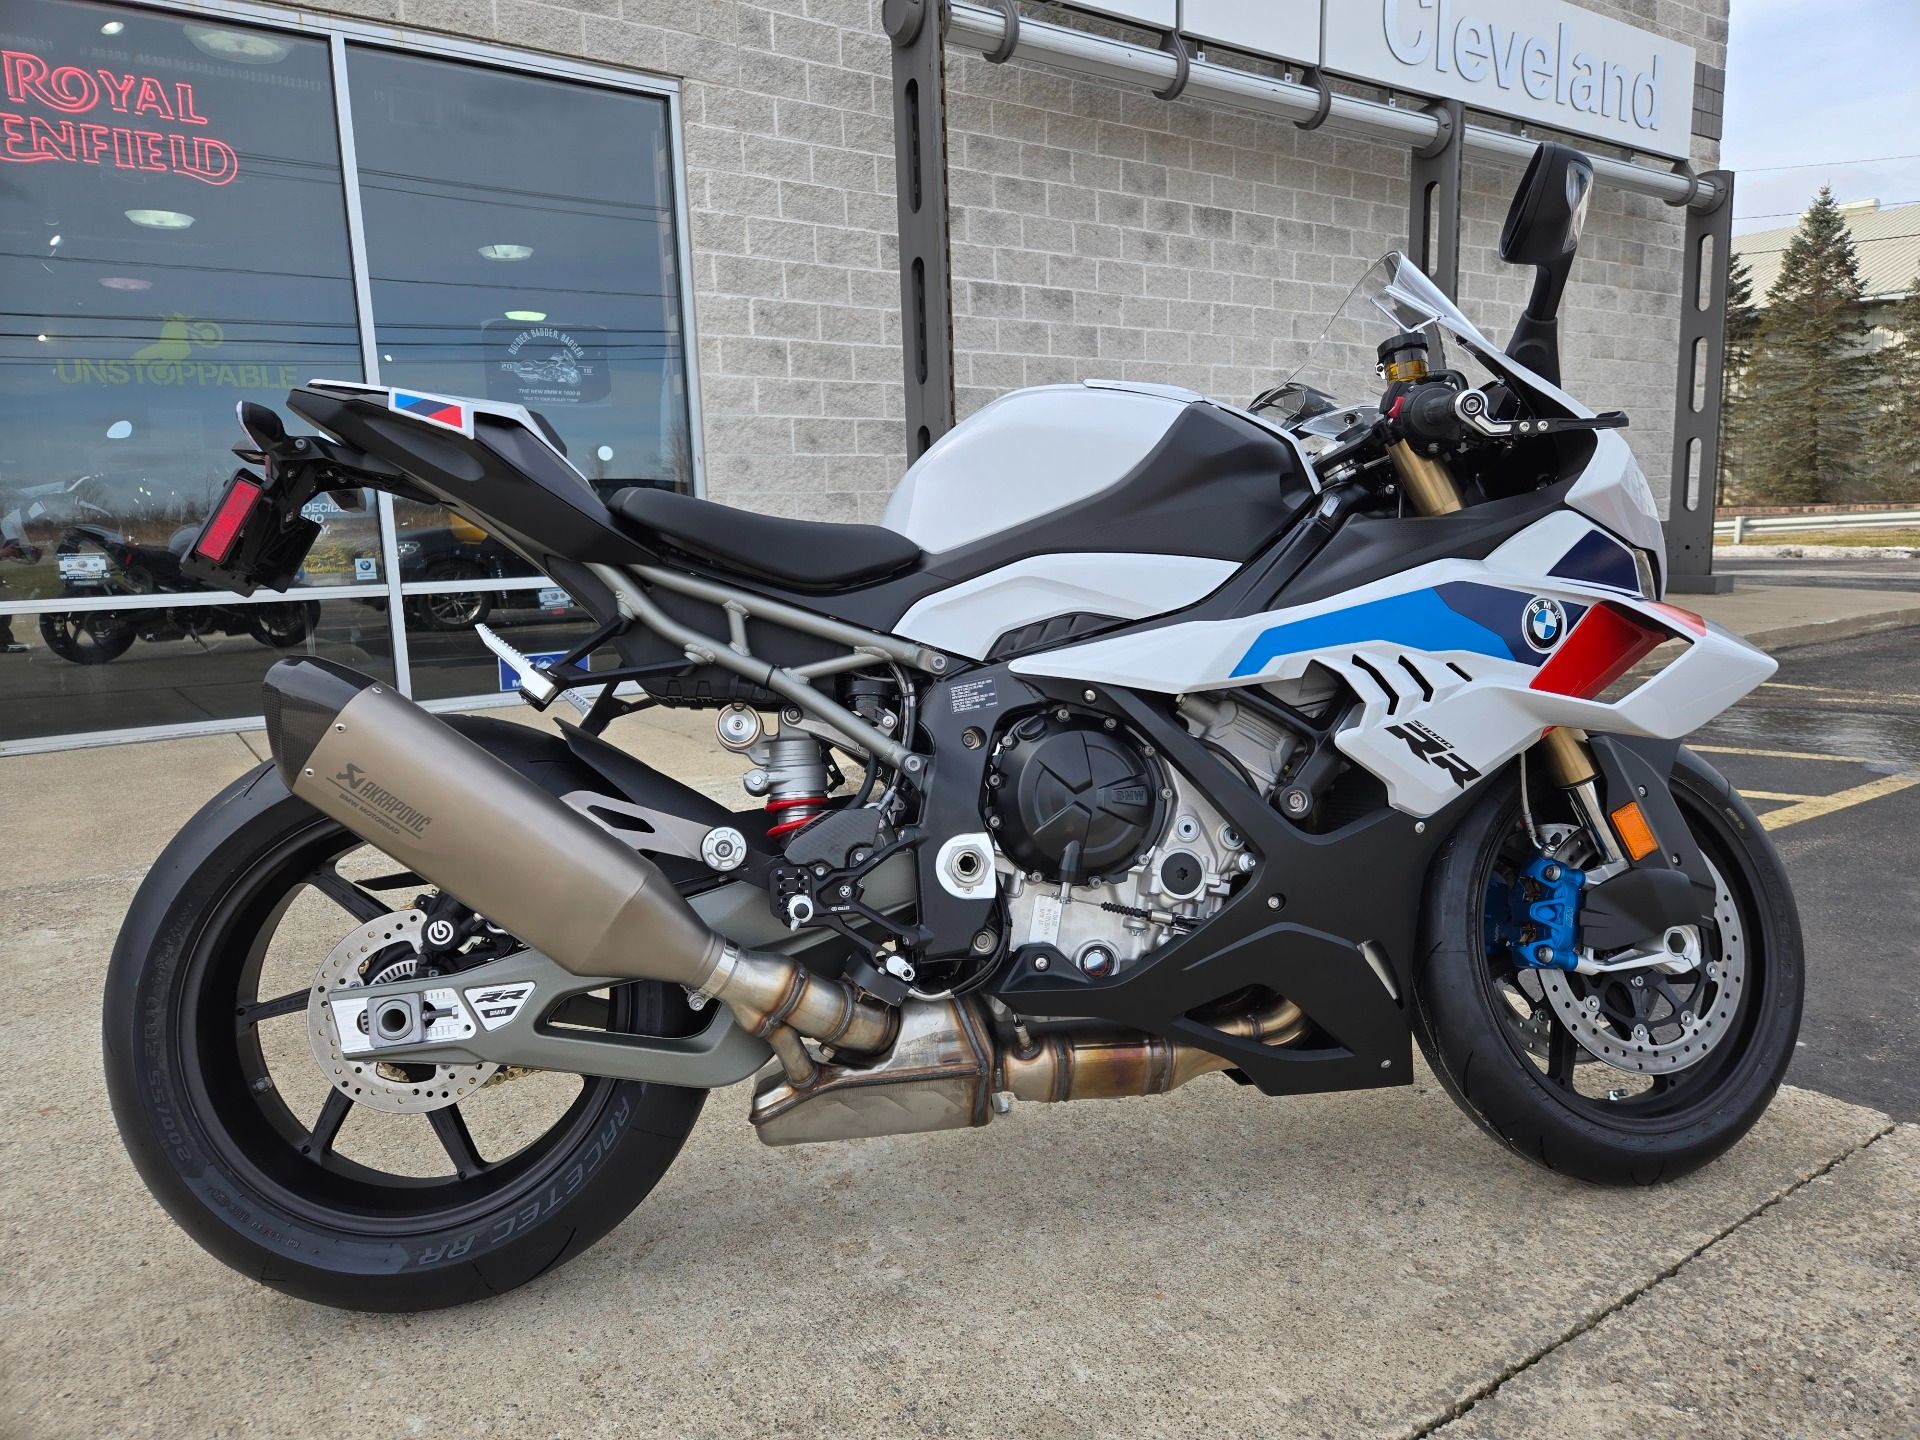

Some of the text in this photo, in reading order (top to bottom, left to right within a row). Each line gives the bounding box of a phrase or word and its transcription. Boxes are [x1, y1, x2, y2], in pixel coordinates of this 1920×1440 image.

[1383, 0, 1664, 130] Cleveland
[1, 50, 209, 125] ROYAL
[0, 112, 239, 186] ENFIELD
[56, 357, 299, 389] UNSTOPPABLE
[1531, 601, 1562, 620] BMW
[1384, 722, 1482, 790] RR
[339, 793, 401, 835] BMW MOTORRAD
[1115, 788, 1145, 801] BMW
[474, 988, 529, 1004] RR
[489, 1008, 507, 1017] BMW
[418, 1096, 630, 1265] RACETEC RR
